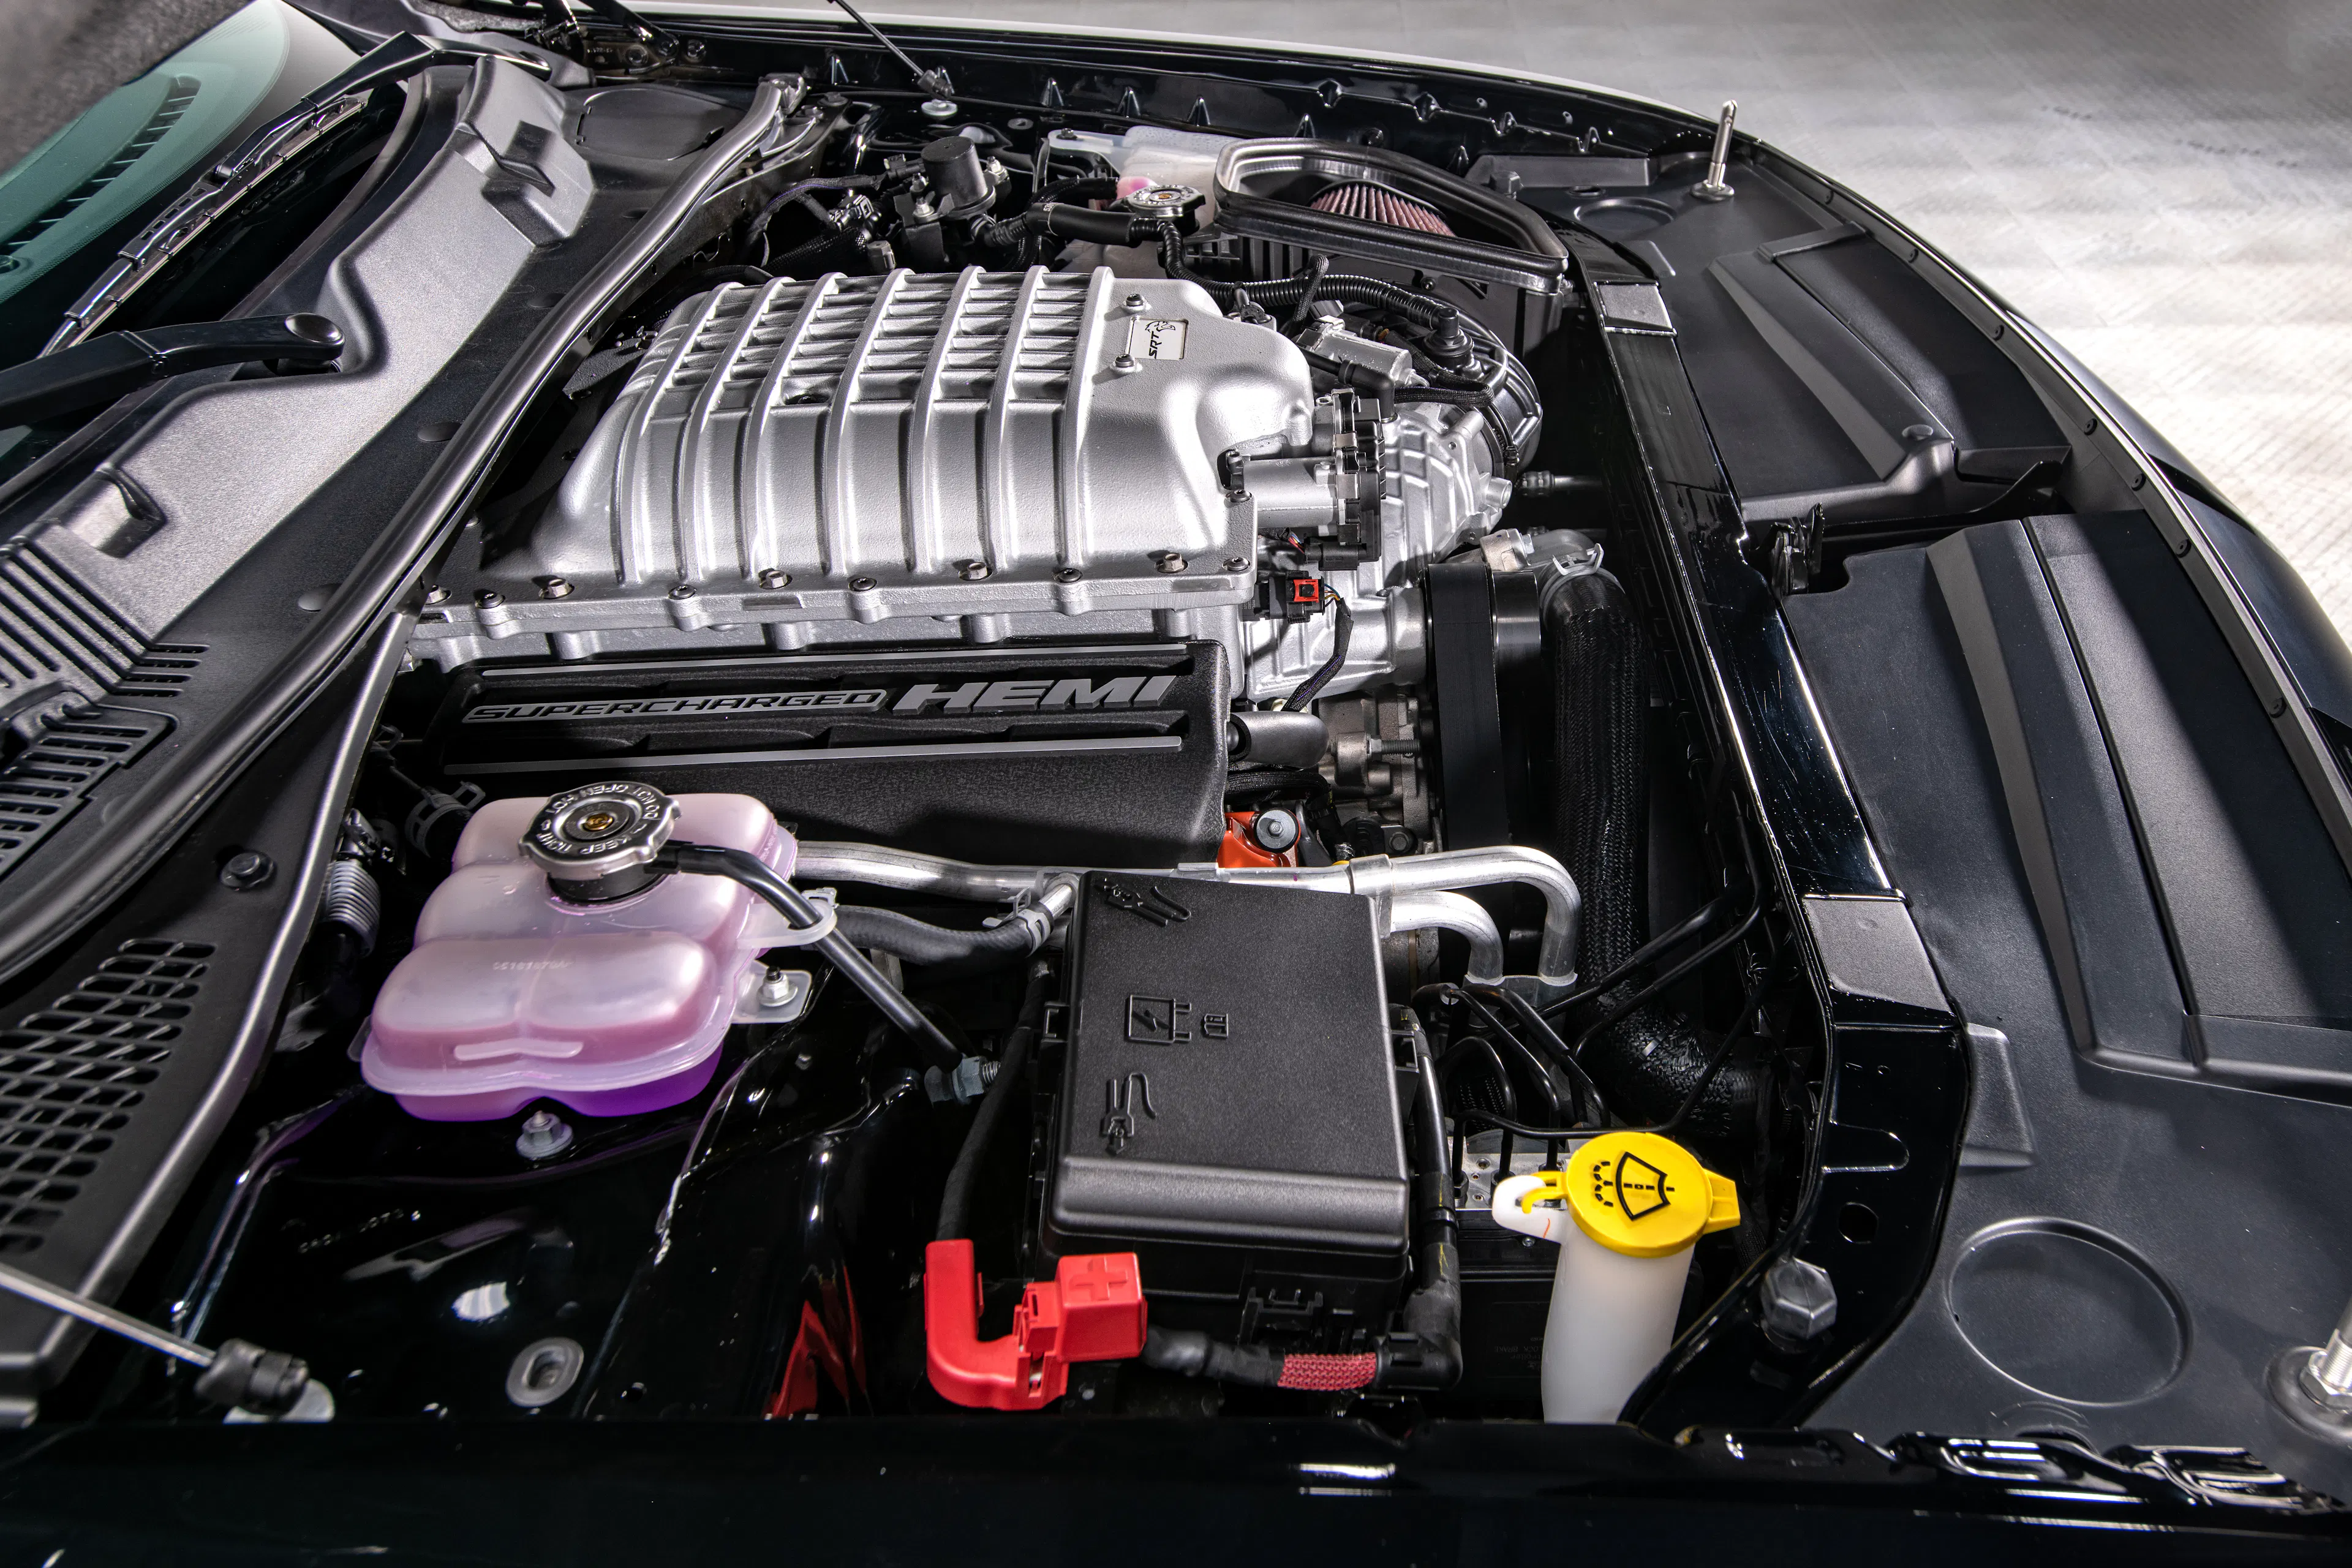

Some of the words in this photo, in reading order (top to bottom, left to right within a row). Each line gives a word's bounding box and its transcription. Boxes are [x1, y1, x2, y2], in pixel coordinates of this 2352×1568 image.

[1149, 331, 1162, 359] SRT
[467, 693, 881, 720] SUPERCHARGED
[892, 676, 1176, 715] HEMI
[580, 783, 628, 796] OPEN
[630, 787, 656, 805] NOT
[546, 794, 578, 814] HOT
[643, 805, 660, 820] DO
[536, 833, 573, 854] TIGHT
[580, 835, 633, 855] KEEP
